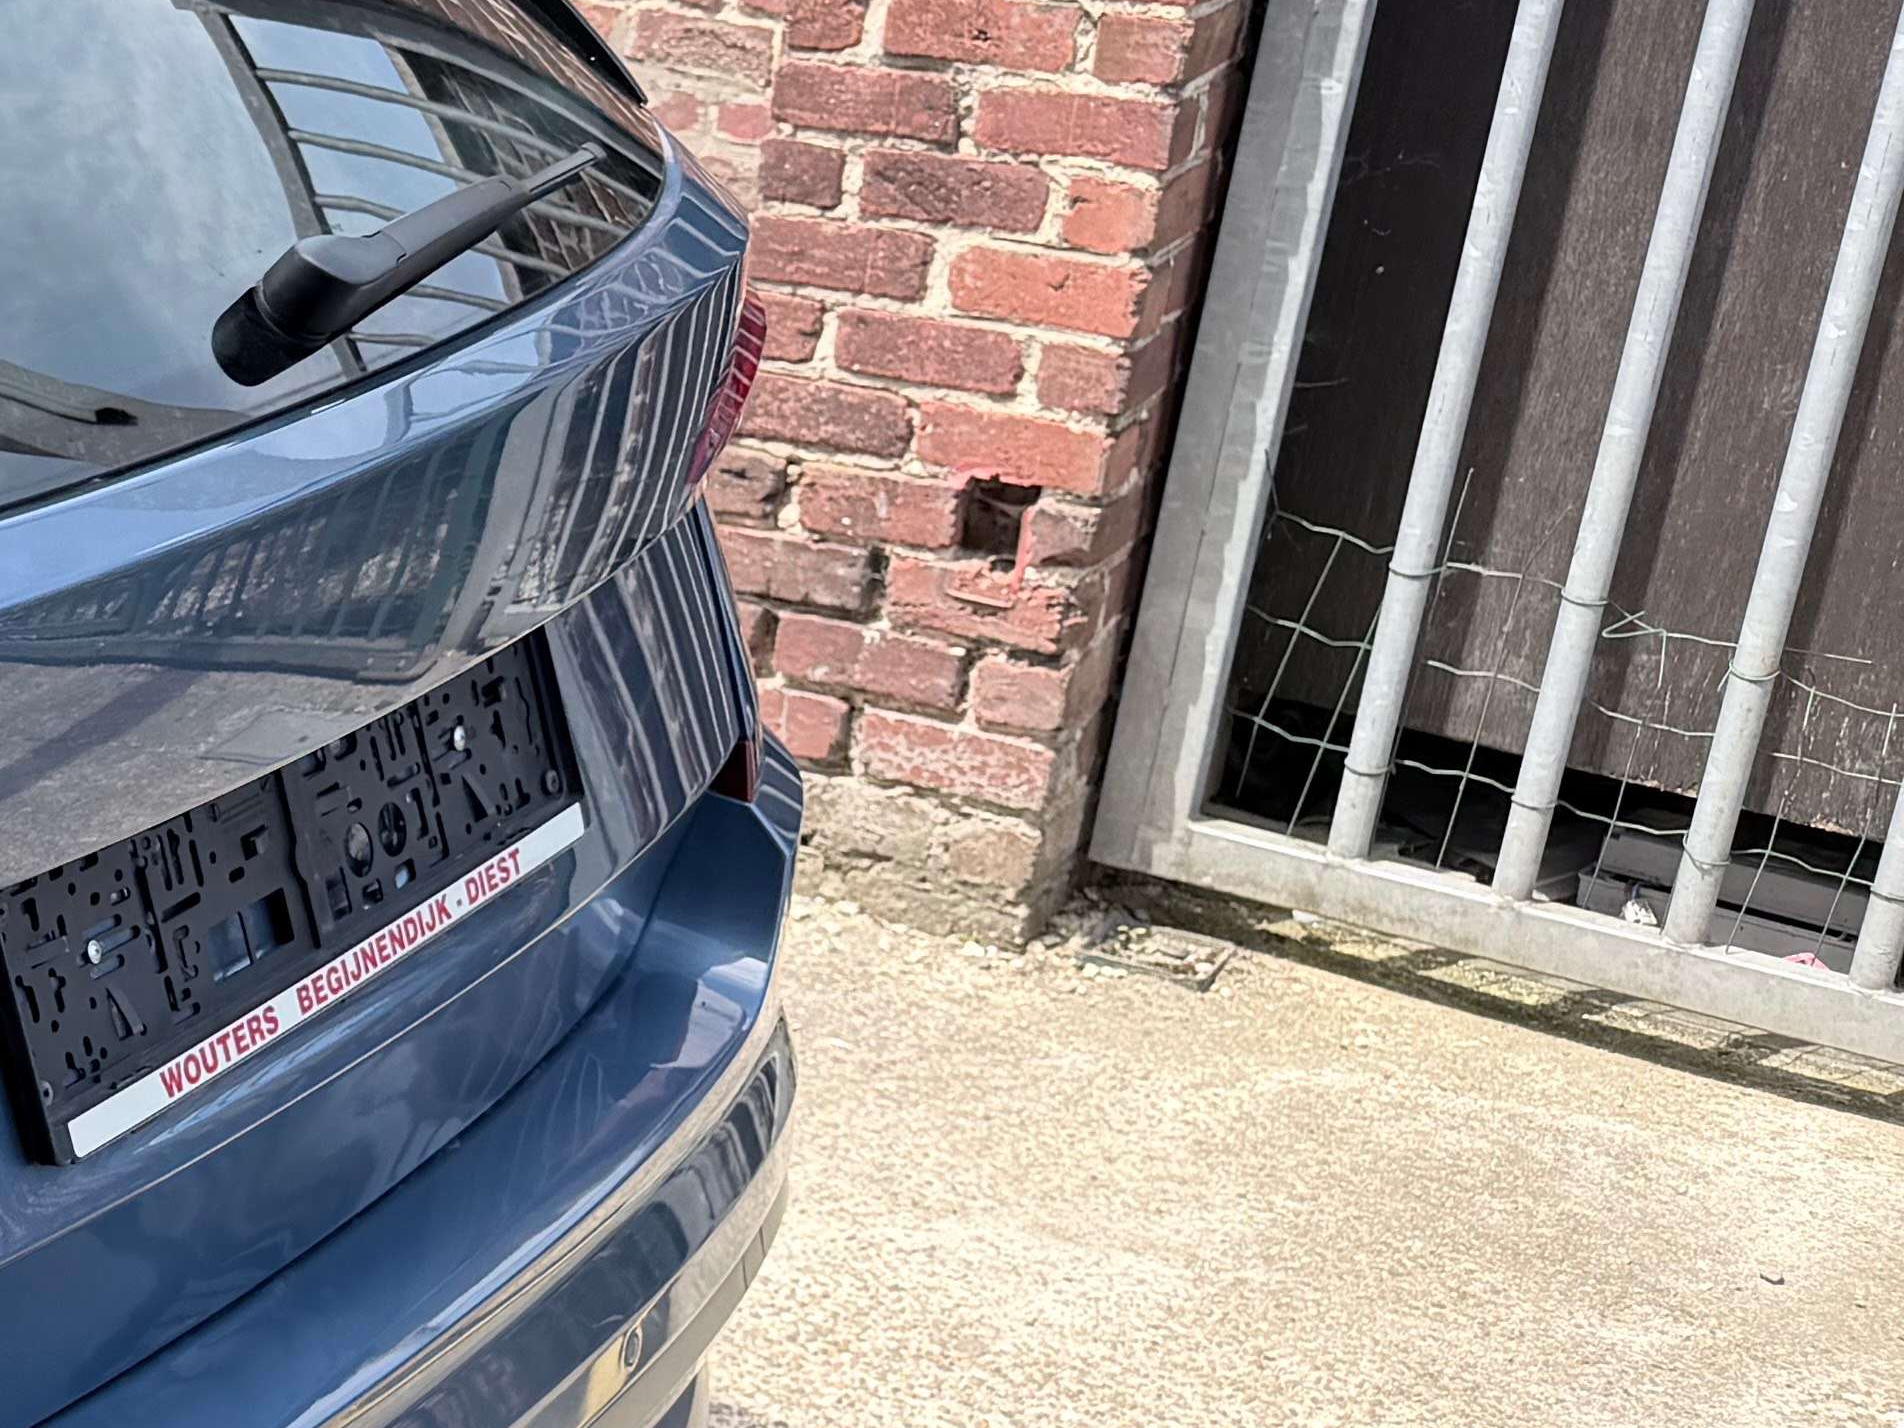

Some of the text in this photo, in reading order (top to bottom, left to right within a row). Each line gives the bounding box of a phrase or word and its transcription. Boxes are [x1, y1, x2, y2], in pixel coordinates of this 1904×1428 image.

[159, 1005, 280, 1099] WOUTERS
[295, 897, 453, 1017] BEGIJNENDIJK
[464, 847, 522, 907] DIEST
